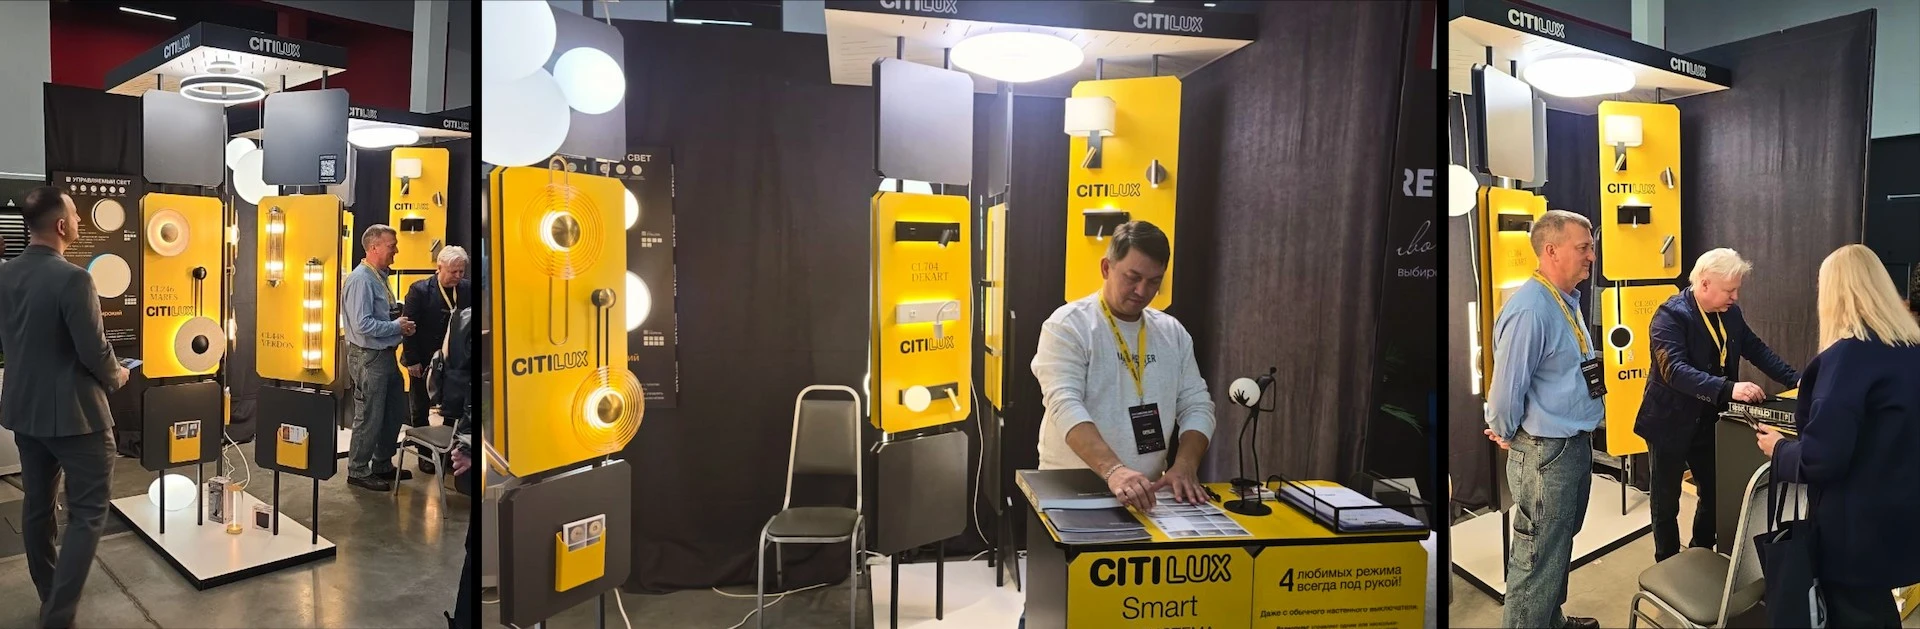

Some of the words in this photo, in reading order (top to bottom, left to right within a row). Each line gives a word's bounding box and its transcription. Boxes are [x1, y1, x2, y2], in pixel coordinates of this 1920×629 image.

[880, 0, 958, 14] CITILUX
[1133, 12, 1203, 33] CITILUX
[1508, 9, 1565, 38] CITILUX
[163, 33, 190, 59] CITILUX
[249, 36, 301, 58] CITILUX
[1670, 57, 1707, 79] CITILUX
[627, 153, 651, 162] СВЕТ
[1076, 183, 1141, 197] CITILUX
[1402, 168, 1437, 198] RE
[1607, 183, 1656, 195] CITILUX
[911, 262, 939, 272] CL704
[911, 272, 949, 282] DEKART
[146, 305, 194, 317] CITILUX
[900, 336, 955, 354] CITILUX
[511, 350, 589, 377] CITILUX
[1089, 554, 1231, 587] CITILUX
[1279, 568, 1294, 592] 4
[1297, 568, 1352, 580] любимых
[1356, 566, 1402, 579] режима
[1297, 581, 1337, 592] всегда
[1340, 580, 1362, 591] под
[1365, 576, 1402, 591] рукой!
[1122, 595, 1198, 620] Smart
[1260, 610, 1281, 618] Даже
